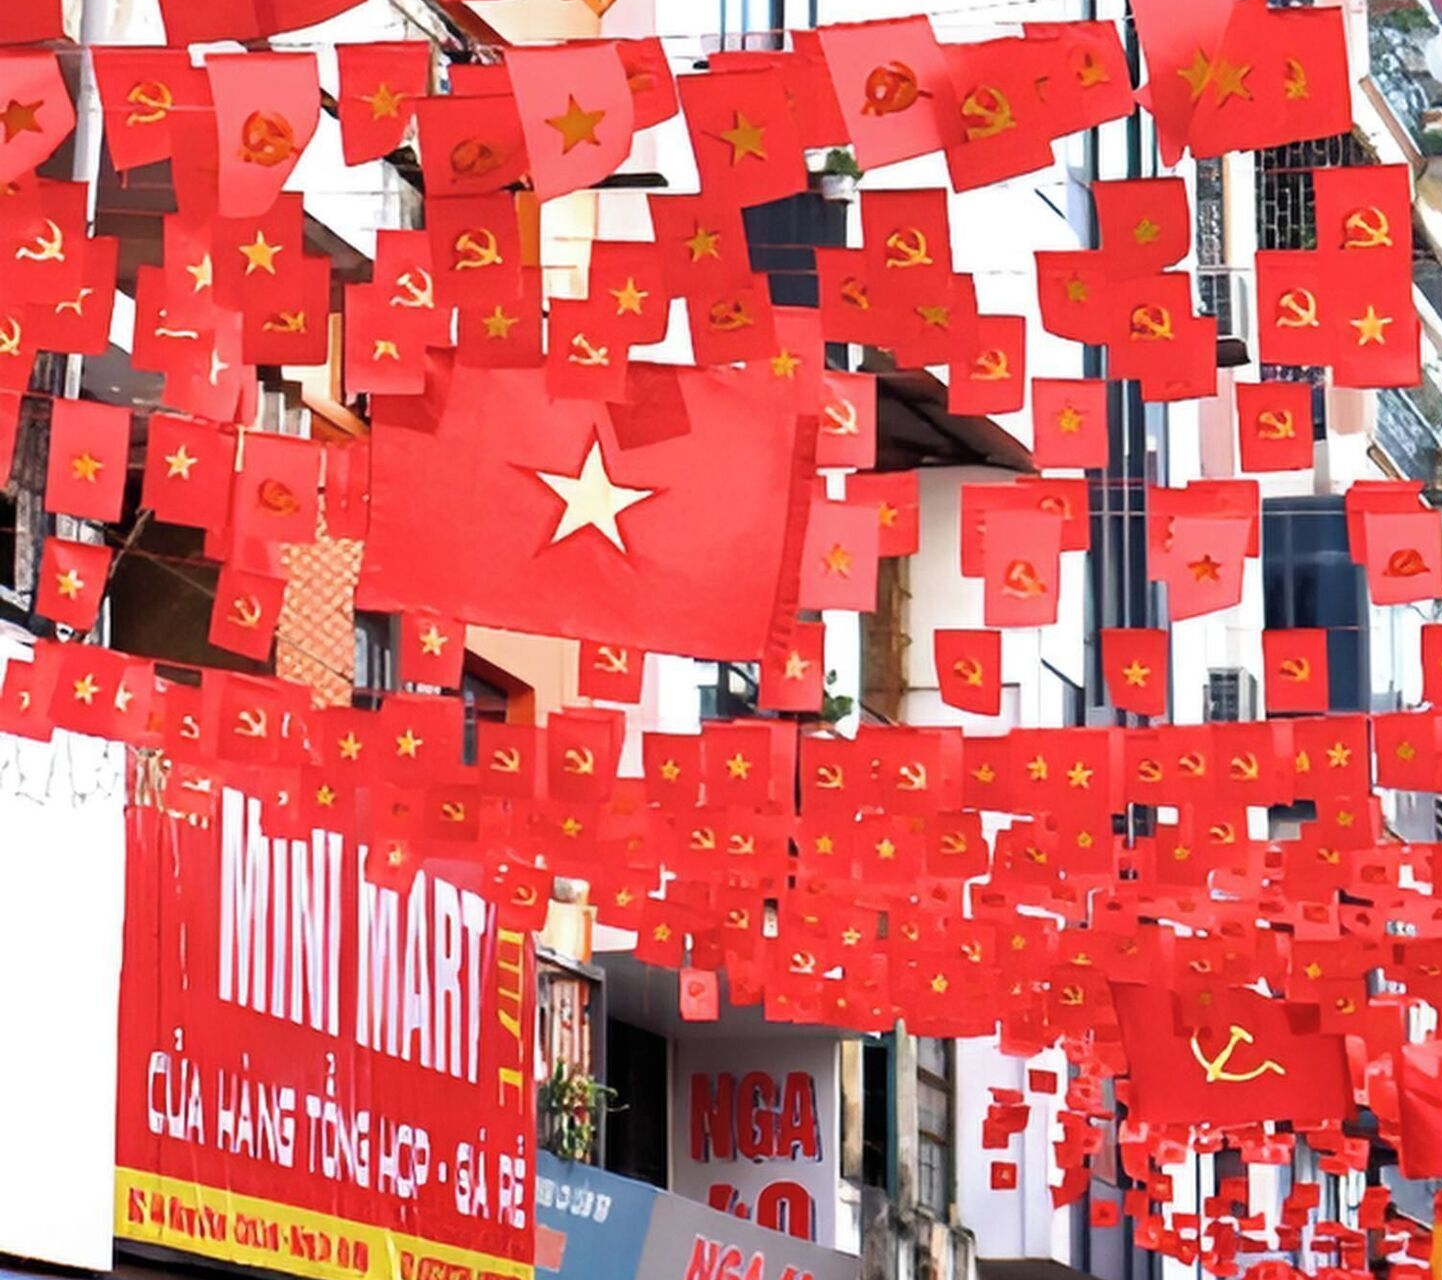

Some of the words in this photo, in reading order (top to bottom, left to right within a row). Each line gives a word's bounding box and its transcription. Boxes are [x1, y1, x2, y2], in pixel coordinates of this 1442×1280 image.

[219, 786, 343, 1037] MINI
[356, 843, 487, 1084] MART
[691, 1072, 822, 1163] NGA
